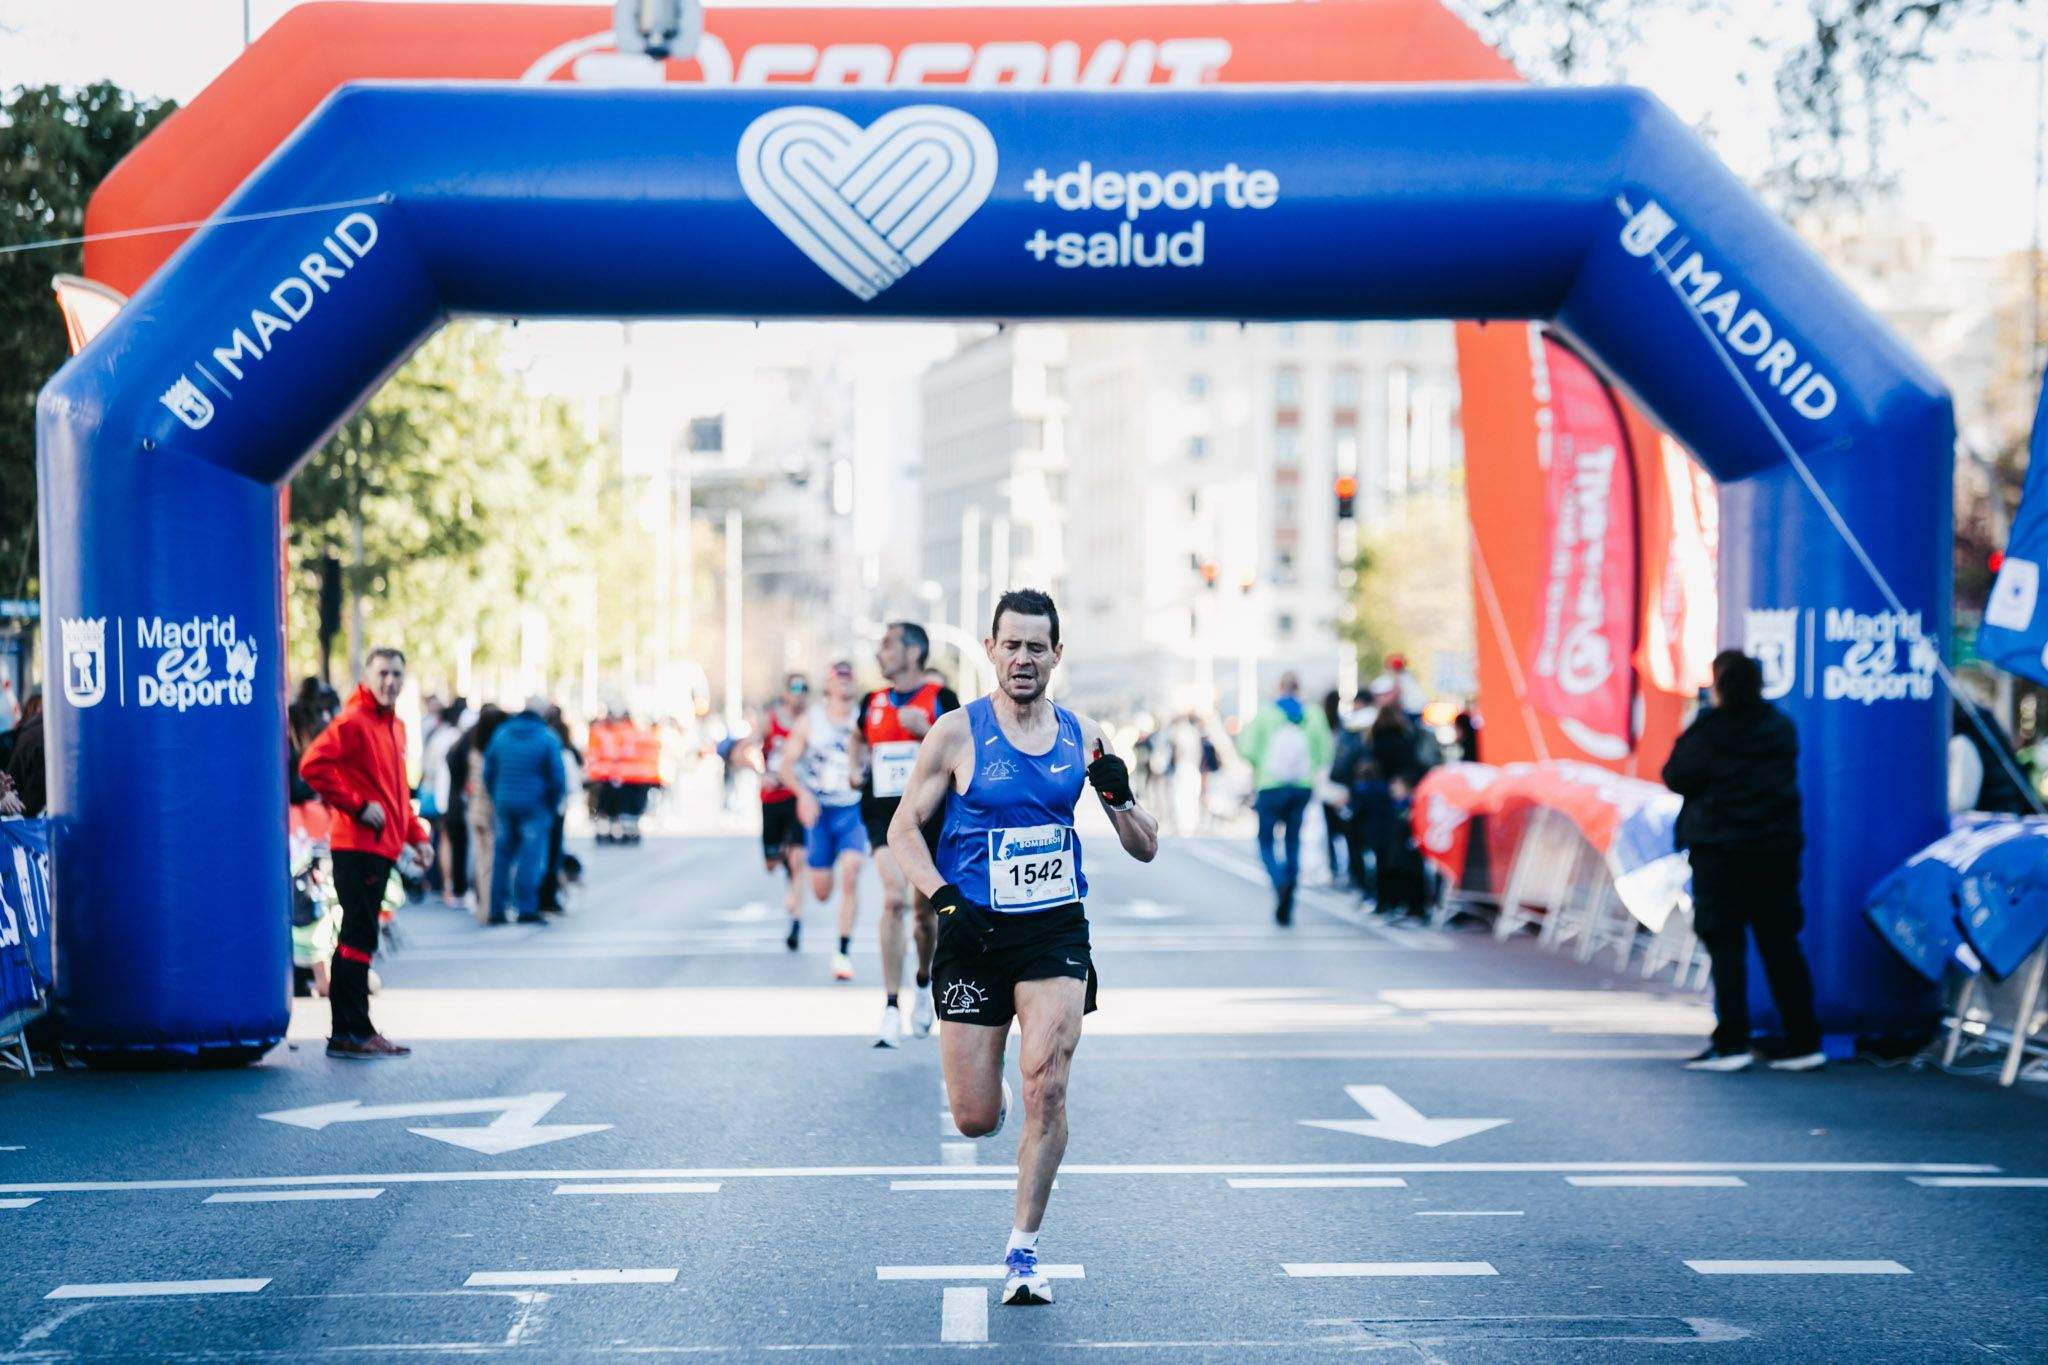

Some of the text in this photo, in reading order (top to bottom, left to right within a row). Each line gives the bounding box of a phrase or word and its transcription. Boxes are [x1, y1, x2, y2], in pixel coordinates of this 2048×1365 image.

[1024, 161, 1279, 221] +deporte
[1025, 220, 1205, 268] +salud
[212, 212, 378, 381] MADRID
[1669, 251, 1838, 420] MADRID
[137, 614, 236, 649] Madrid
[1824, 606, 1922, 642] Madrid
[157, 647, 211, 683] es
[1843, 639, 1898, 677] es
[138, 674, 253, 713] Deporte
[1823, 665, 1934, 706] Deporte
[1009, 858, 1063, 886] 1542
